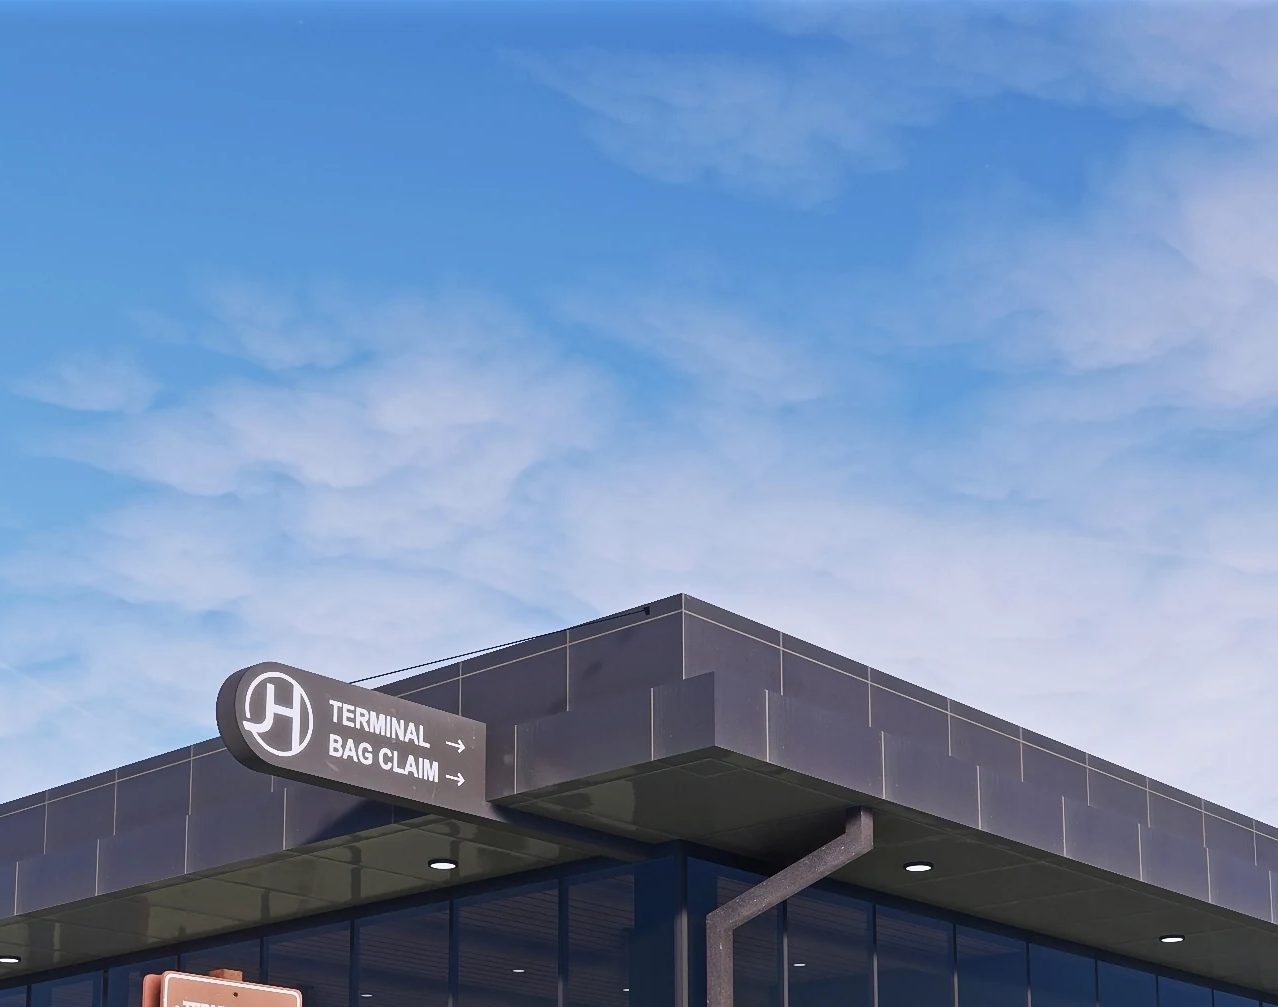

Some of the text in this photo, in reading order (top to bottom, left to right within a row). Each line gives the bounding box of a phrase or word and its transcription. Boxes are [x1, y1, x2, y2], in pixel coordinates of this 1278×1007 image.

[329, 699, 430, 748] TERMINAL
[328, 733, 439, 783] BAG CLAIM
